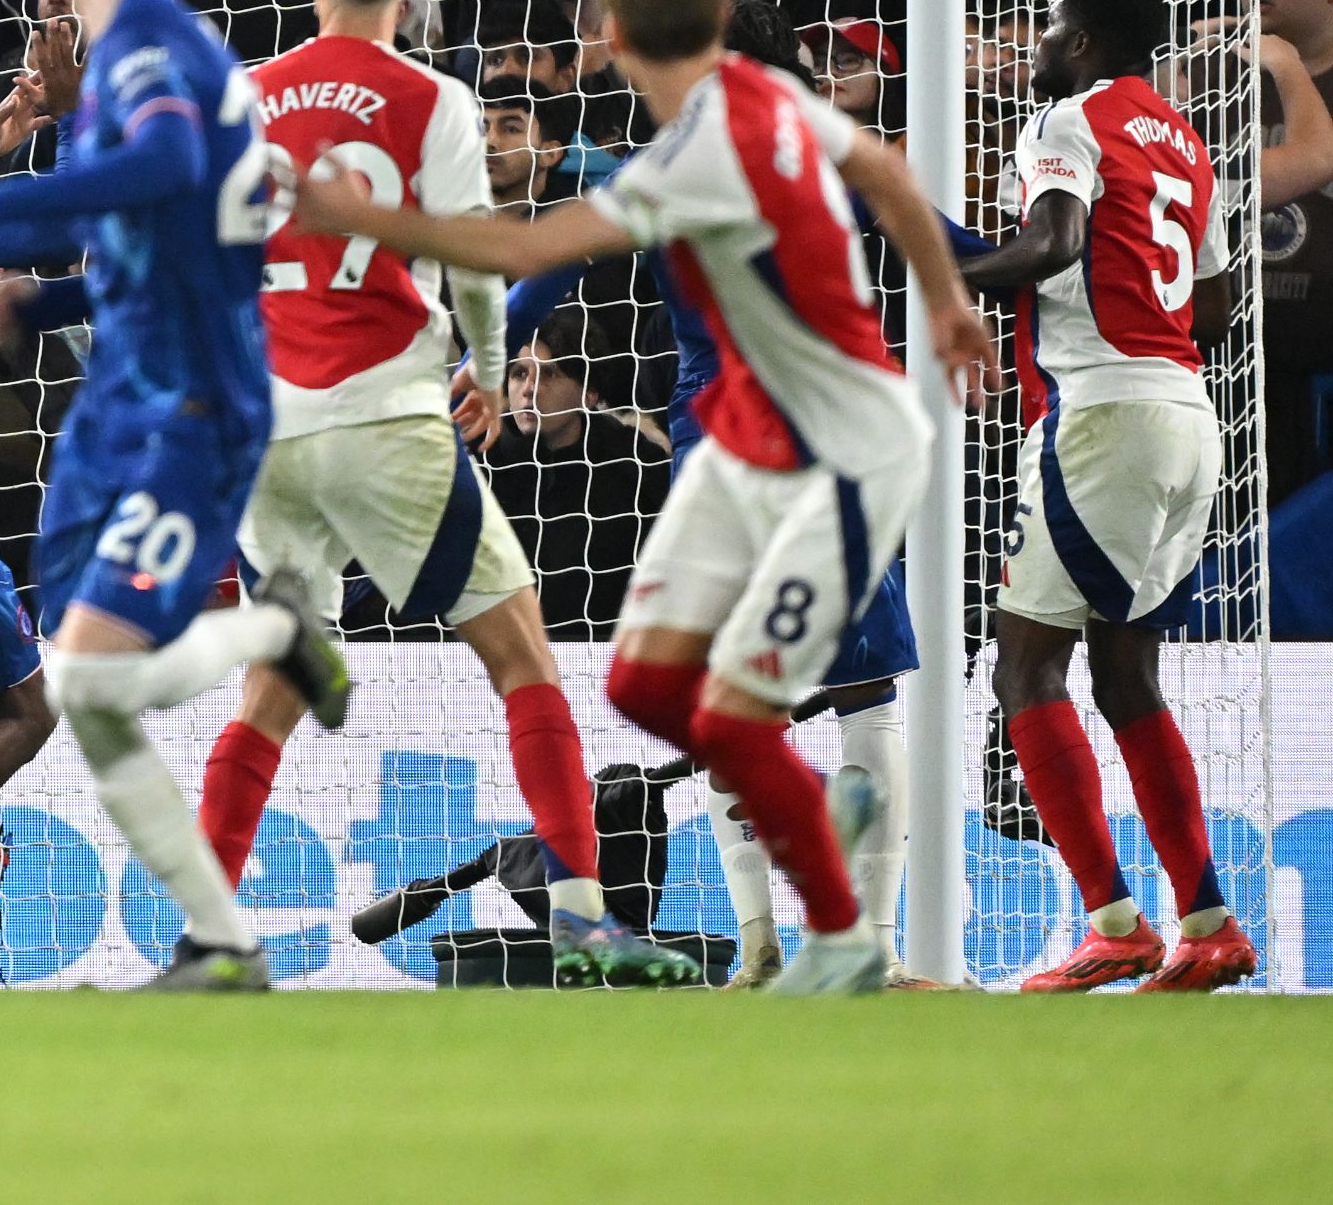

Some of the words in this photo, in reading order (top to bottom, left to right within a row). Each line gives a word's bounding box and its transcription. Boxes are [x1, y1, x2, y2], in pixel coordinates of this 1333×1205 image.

[256, 80, 386, 126] HAVERTZ
[1037, 157, 1063, 167] ISIT
[1123, 115, 1196, 166] THOMAS
[1149, 170, 1192, 312] 5
[95, 491, 197, 586] 20
[764, 578, 816, 644] 8
